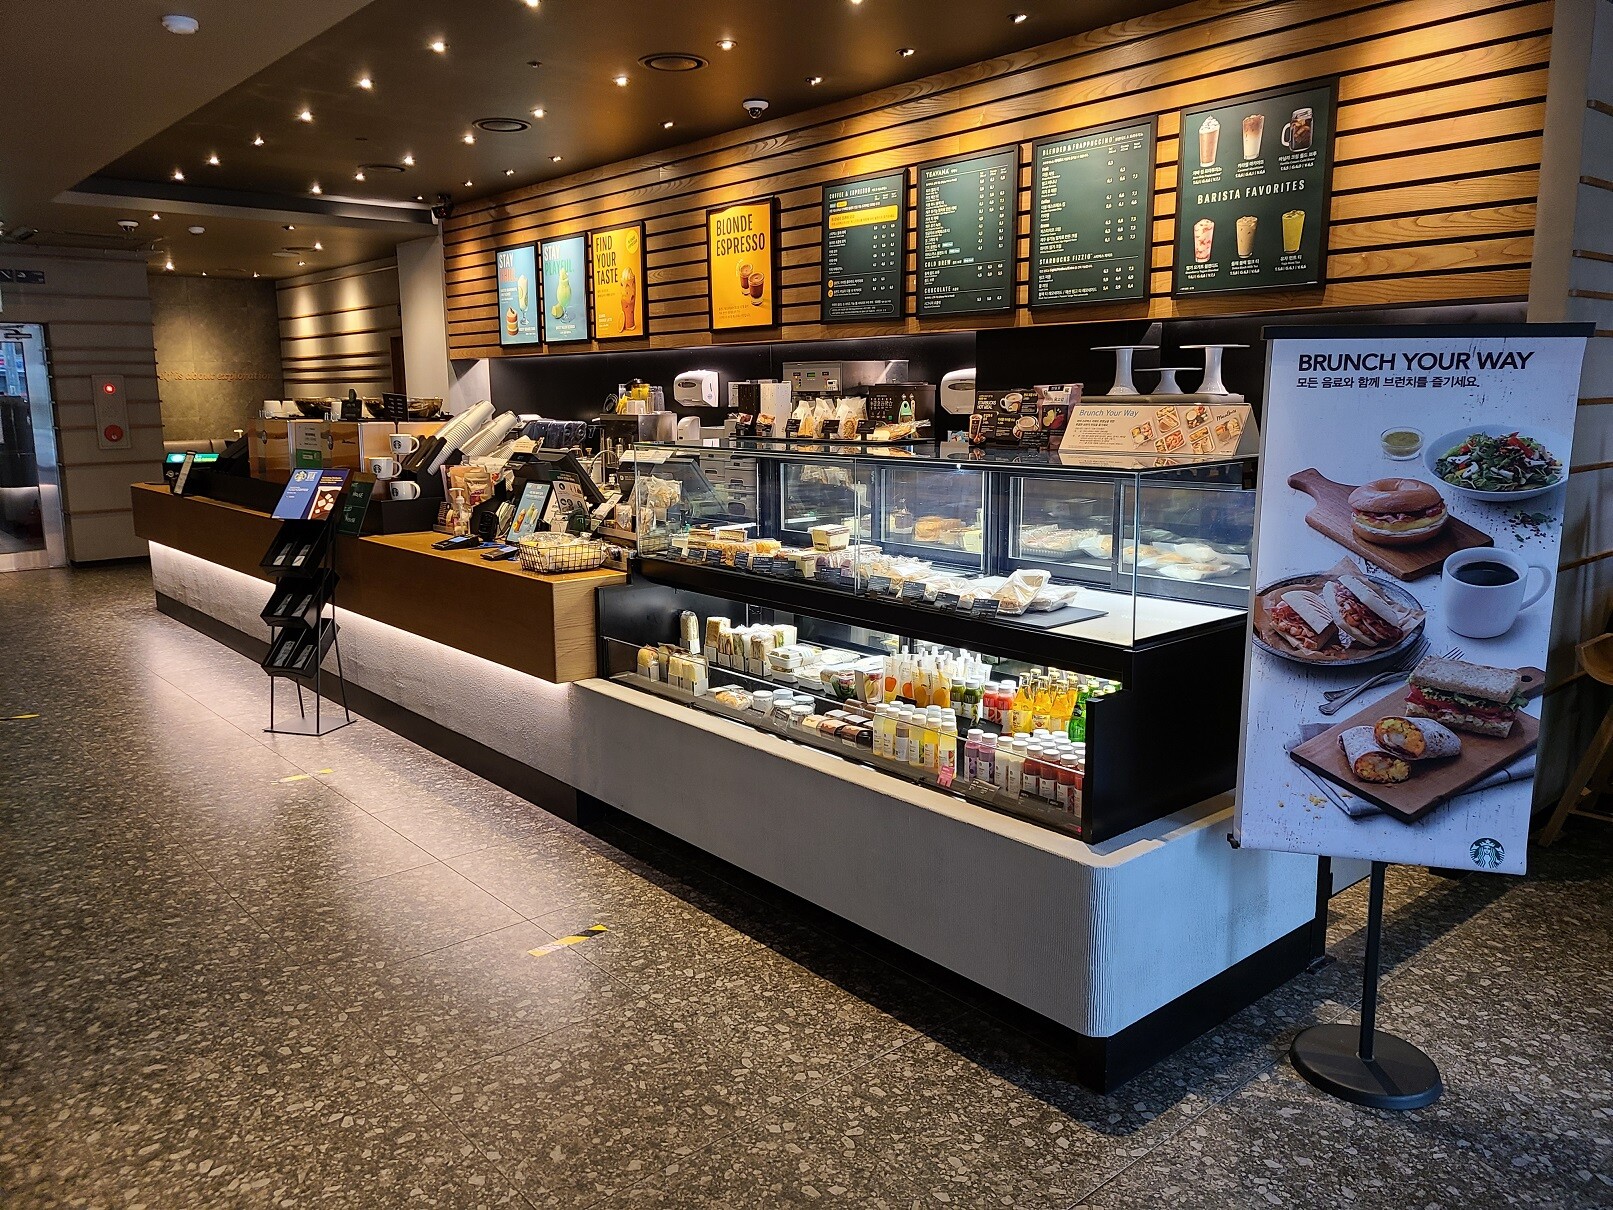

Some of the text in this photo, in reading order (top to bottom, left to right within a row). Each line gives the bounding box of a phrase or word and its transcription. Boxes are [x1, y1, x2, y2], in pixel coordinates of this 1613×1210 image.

[1197, 180, 1306, 205] BARISTA FAVORITES
[716, 214, 752, 236] BLONDE
[596, 236, 612, 252] FIND
[716, 232, 765, 256] ESPRESSO
[499, 253, 514, 269] STAY
[544, 245, 560, 262] STAY
[597, 252, 616, 268] YOUR
[1040, 255, 1071, 265] STARBUCKS
[597, 268, 618, 286] TASTE
[1298, 351, 1535, 372] BRUNCH YOUR WAY
[1296, 376, 1480, 388] 모든 음료와 함께 브런치를 즐기세요.
[1124, 410, 1139, 418] Way
